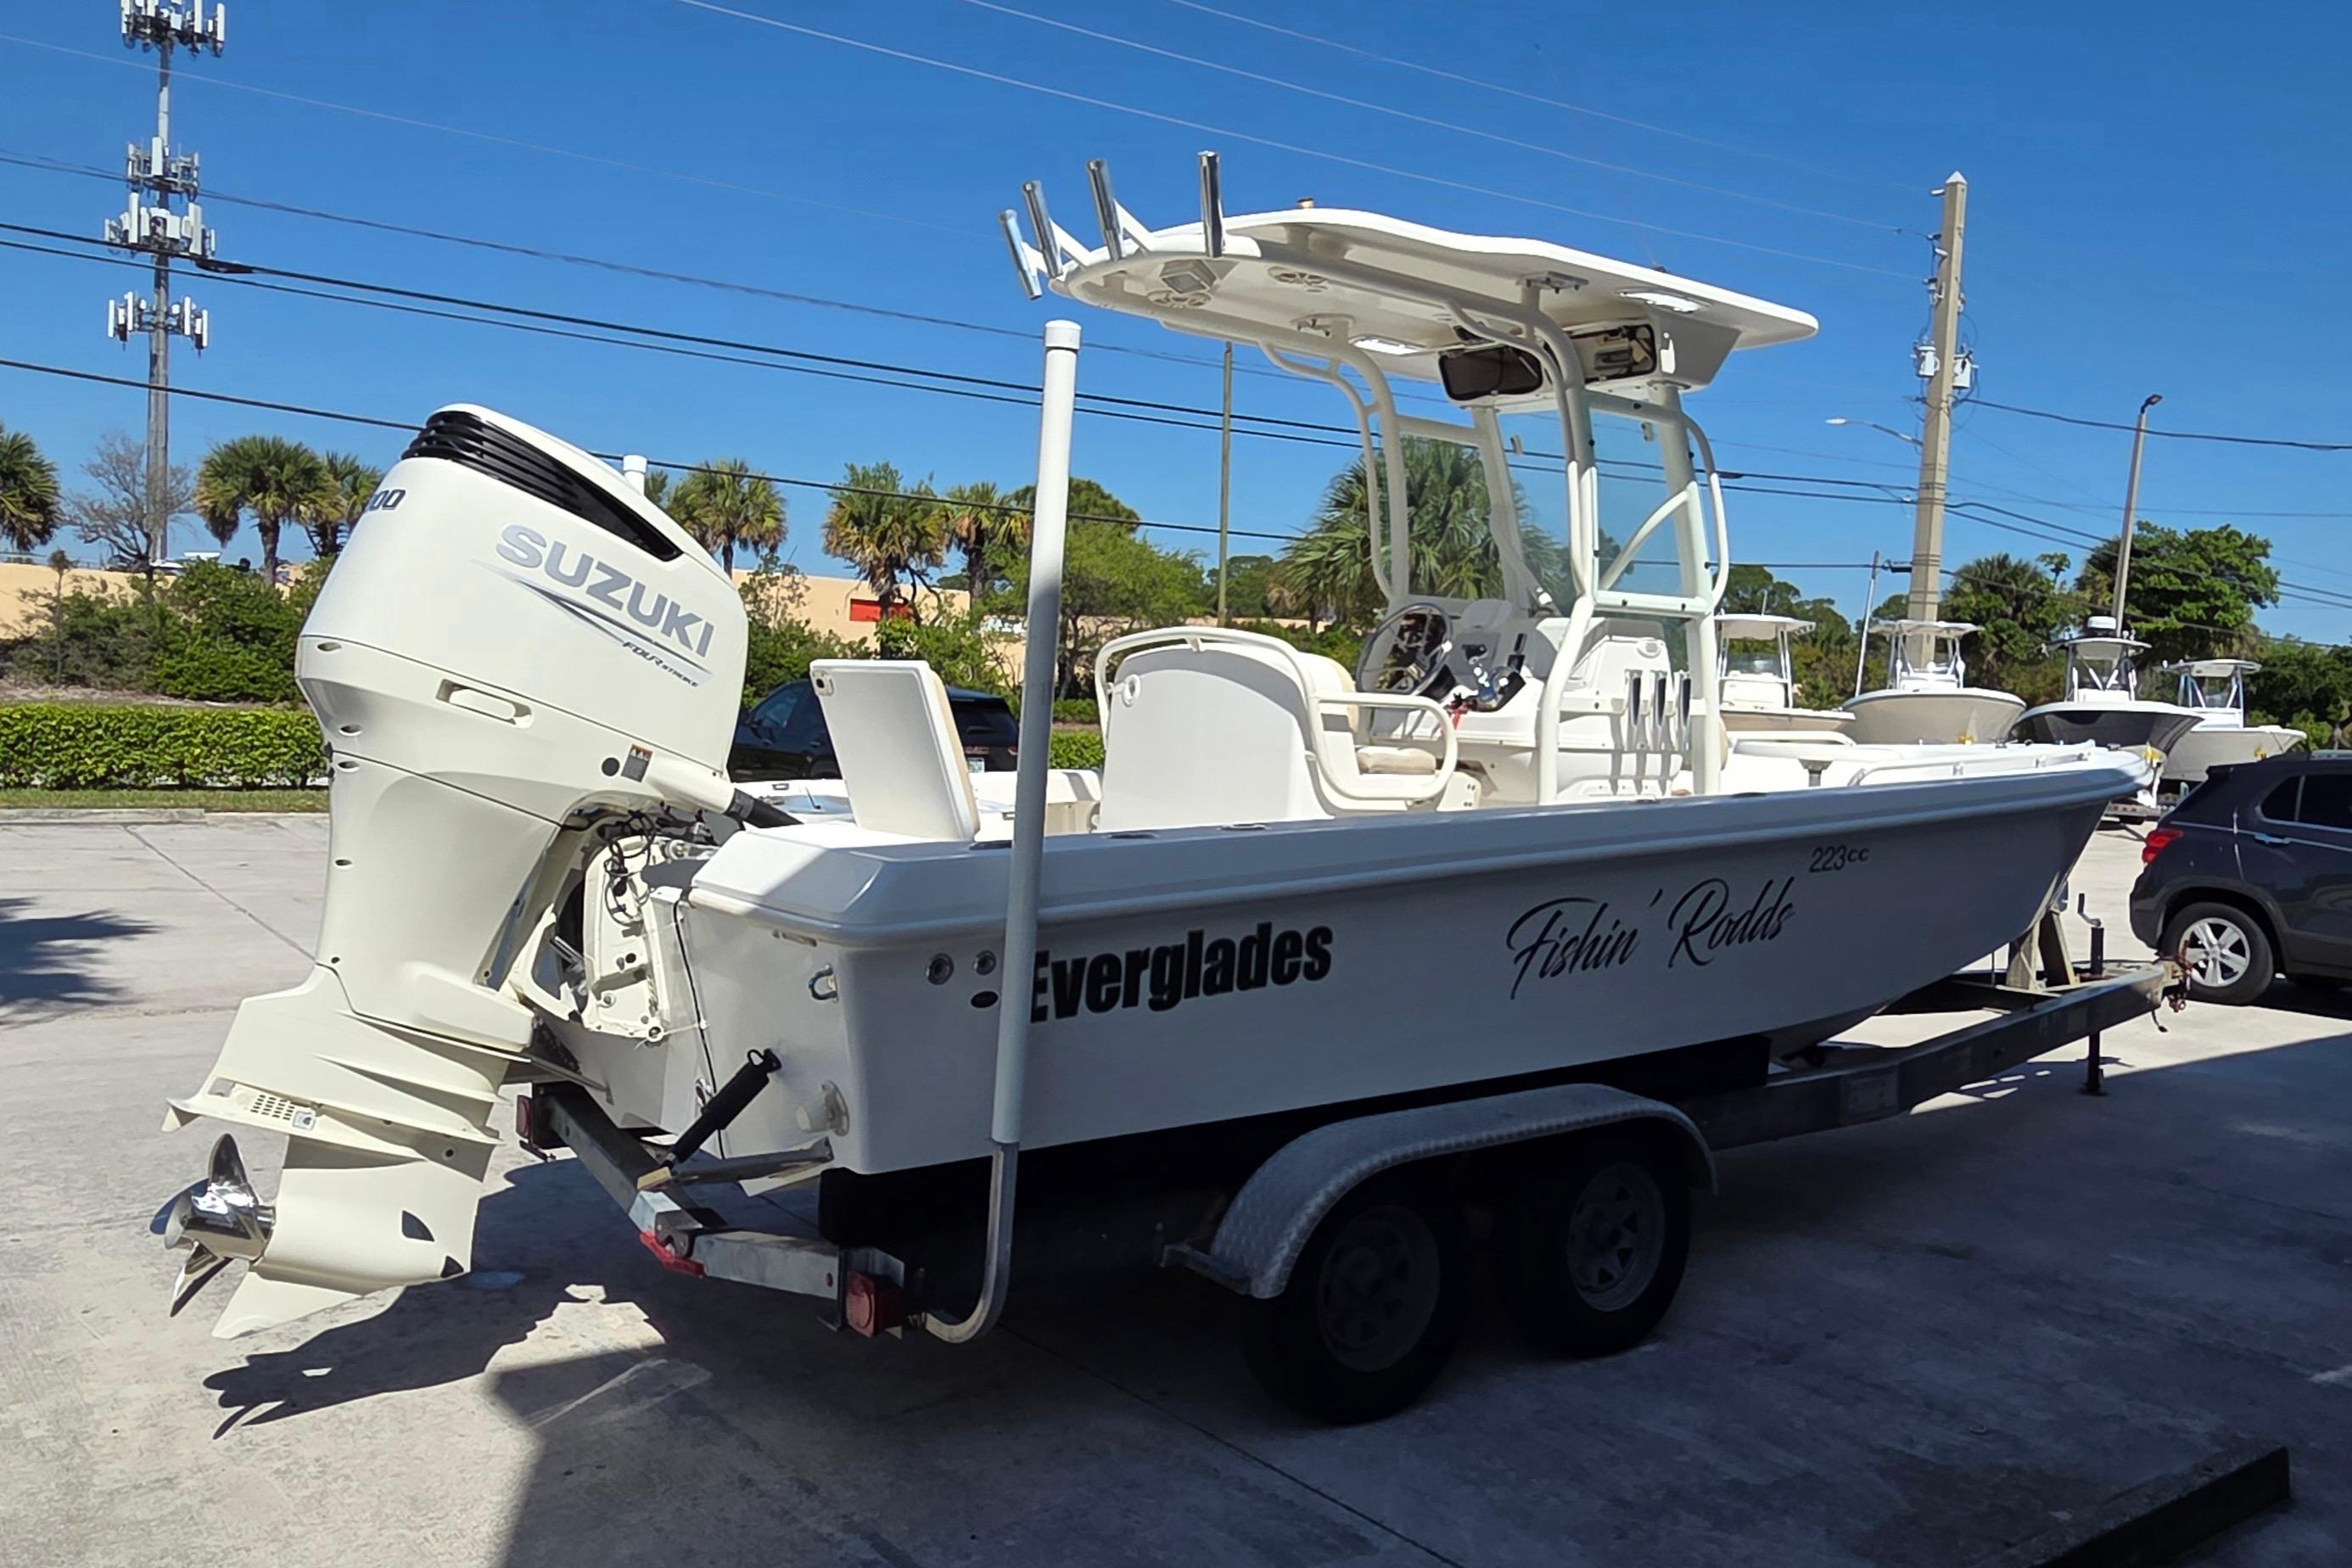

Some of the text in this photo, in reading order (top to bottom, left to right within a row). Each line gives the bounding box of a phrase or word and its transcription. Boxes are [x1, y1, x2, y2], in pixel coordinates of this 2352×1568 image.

[368, 489, 406, 511] 00
[496, 524, 714, 658] SUZUKI
[1667, 876, 1795, 968] Rodds
[1030, 921, 1333, 1023] Everglades
